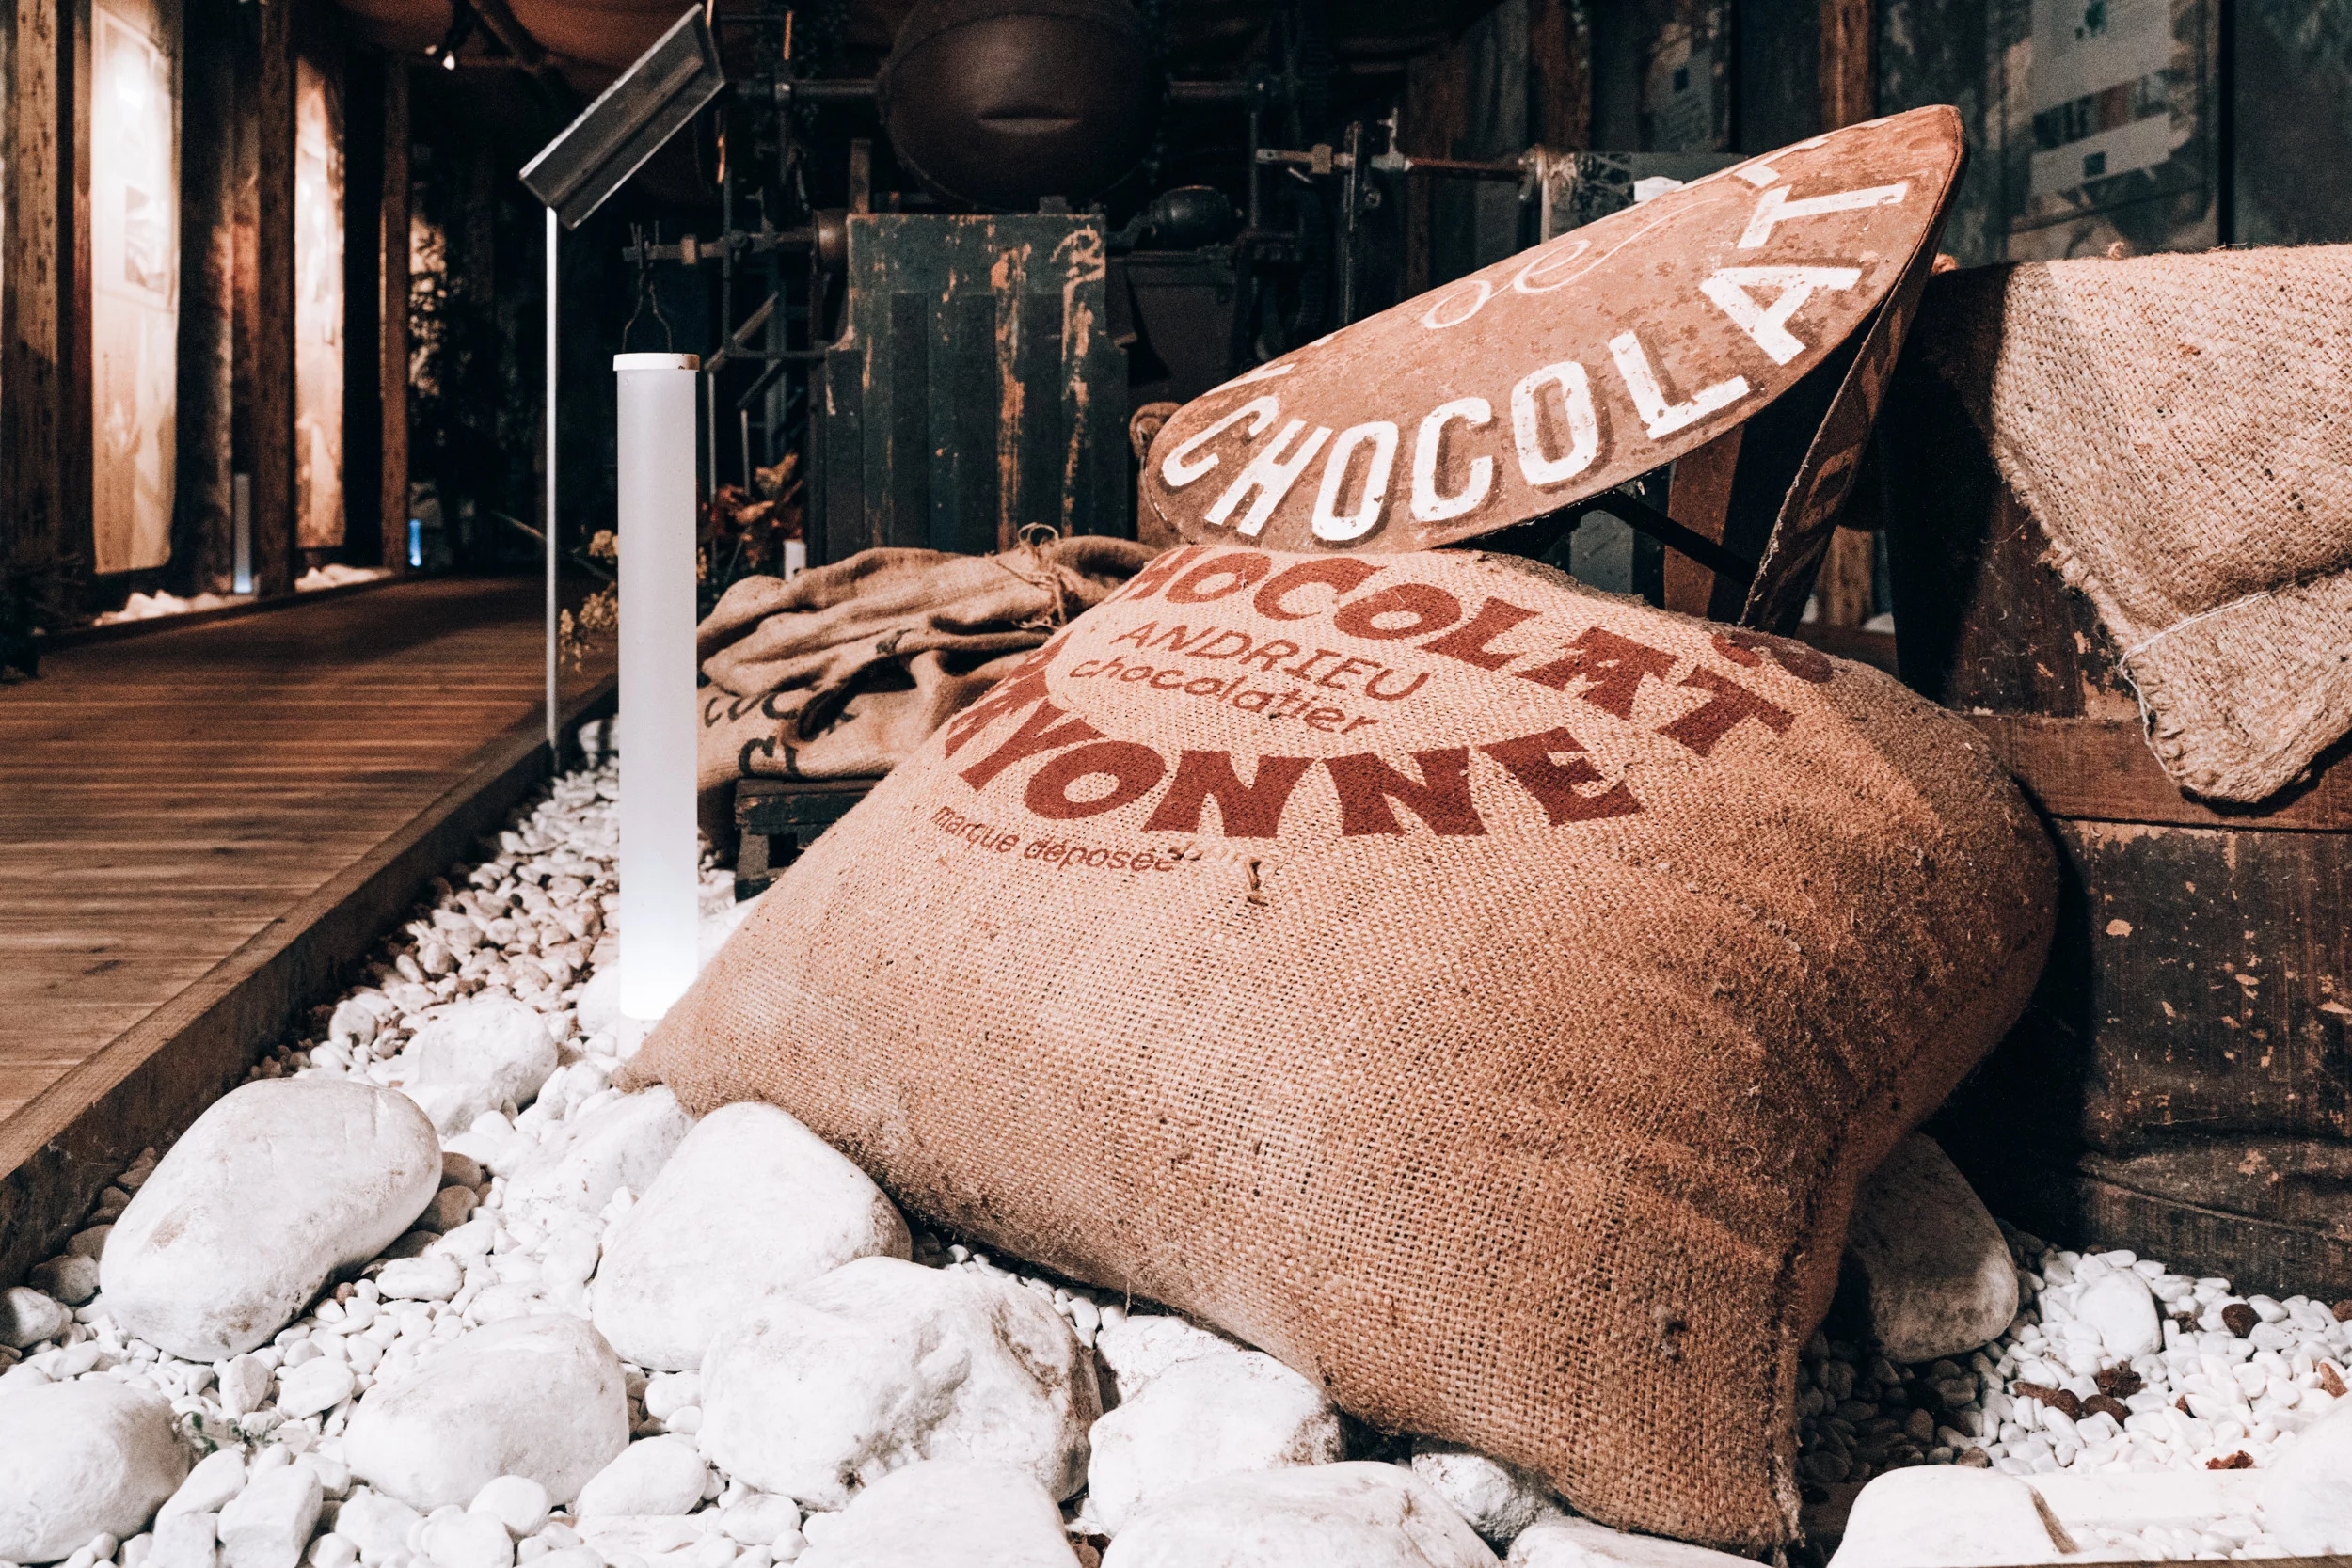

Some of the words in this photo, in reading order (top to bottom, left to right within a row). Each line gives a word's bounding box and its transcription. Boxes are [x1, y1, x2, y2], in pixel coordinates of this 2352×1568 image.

[1162, 182, 1907, 542] CHOCOLAT
[1104, 545, 1795, 757] HOCOLAT
[1109, 621, 1429, 702] ANDRIEU
[1069, 656, 1380, 735] chocolatier
[930, 805, 1020, 853] marque
